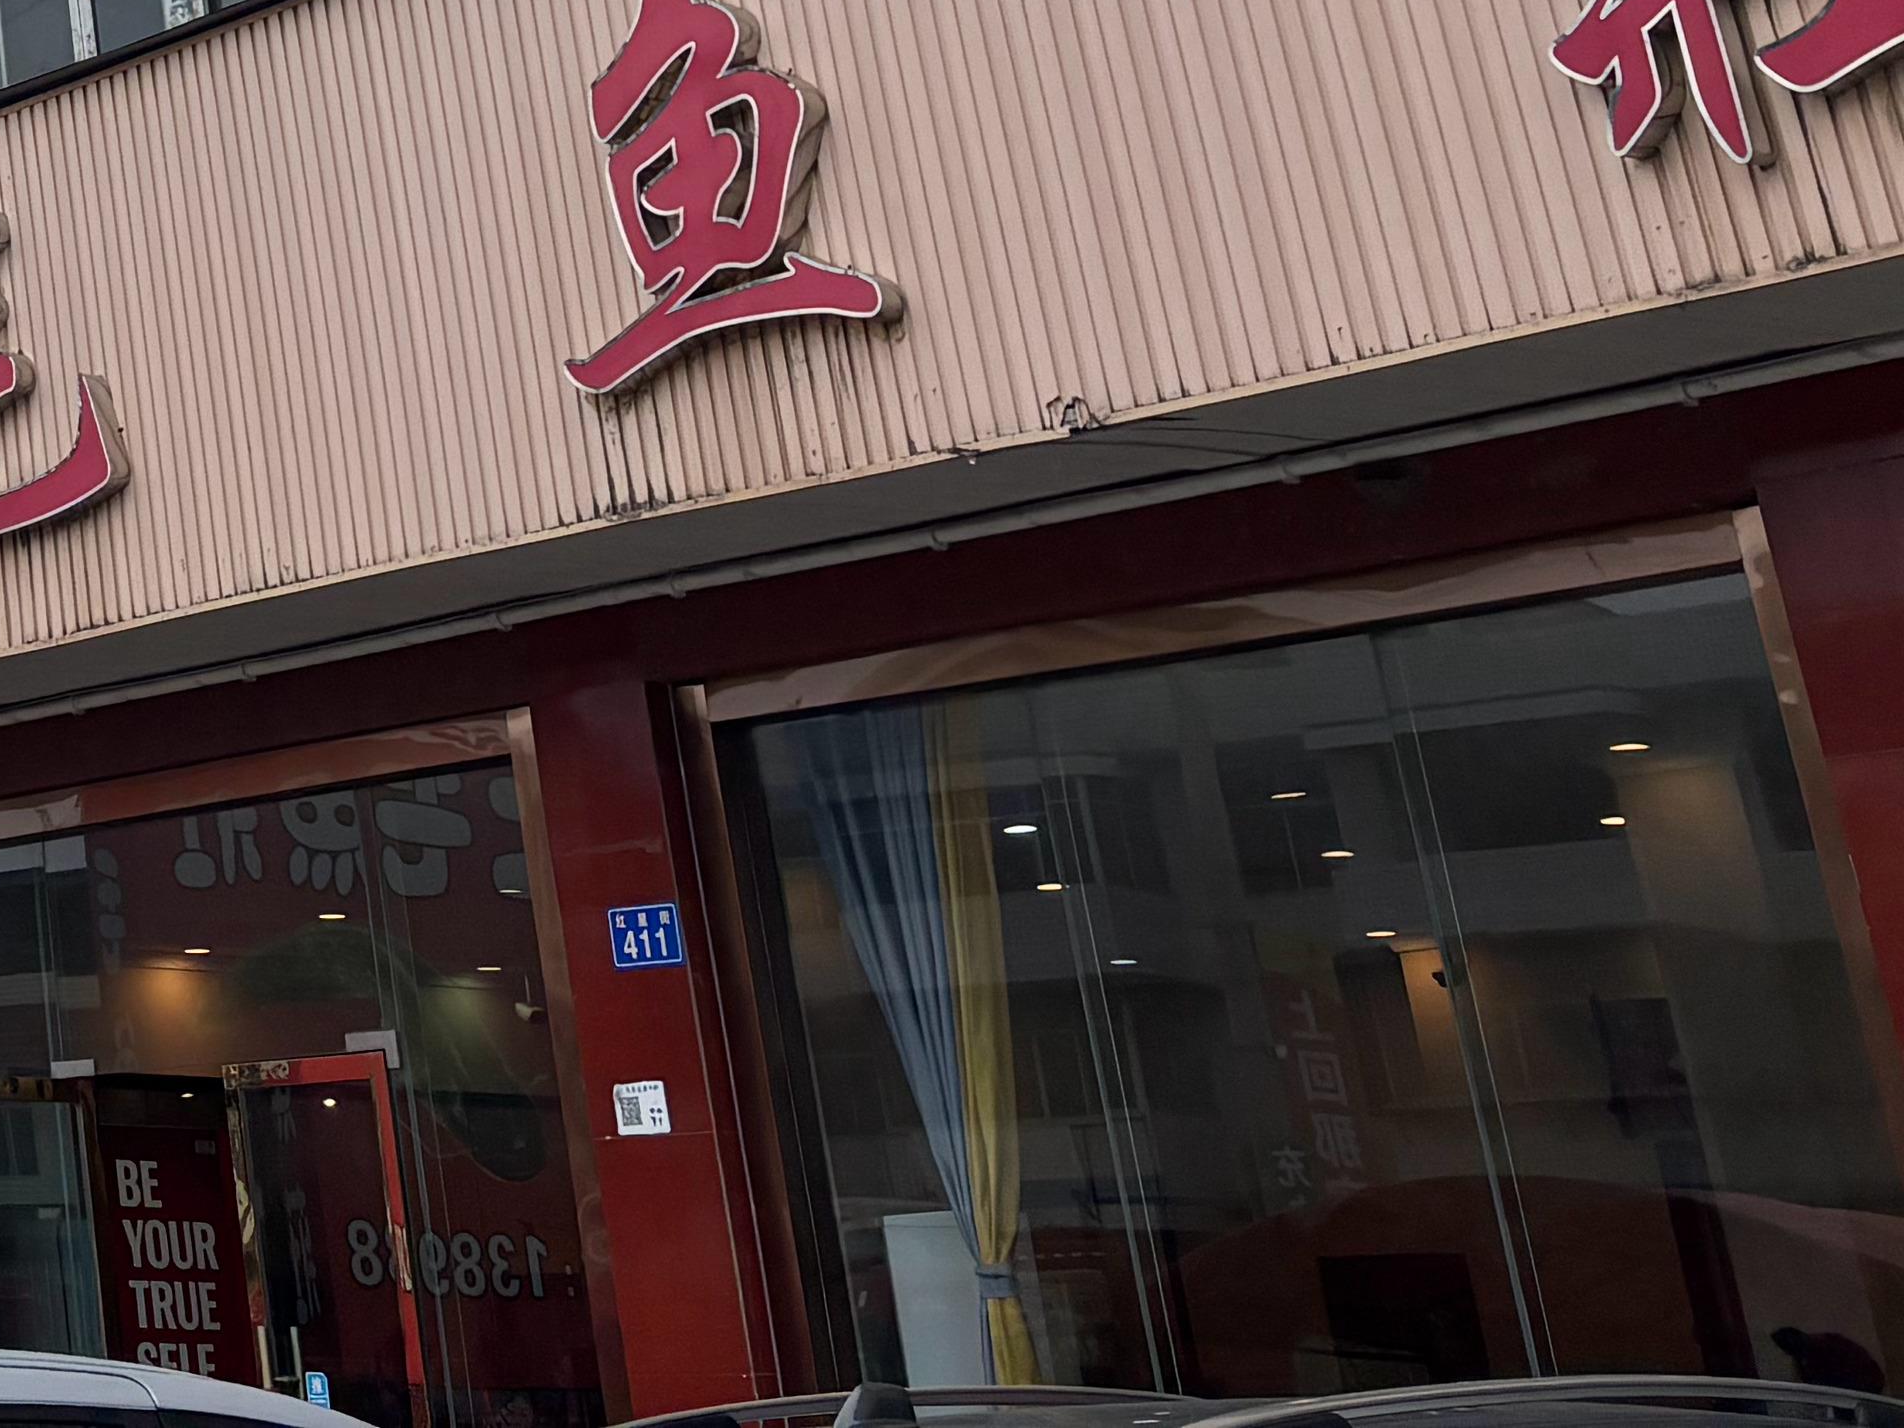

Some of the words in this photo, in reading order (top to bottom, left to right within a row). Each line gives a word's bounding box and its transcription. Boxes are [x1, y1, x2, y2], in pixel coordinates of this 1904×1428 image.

[624, 927, 667, 959] 411
[115, 1159, 162, 1208] BE
[122, 1219, 219, 1270] YOUR
[128, 1280, 220, 1330] TRUE
